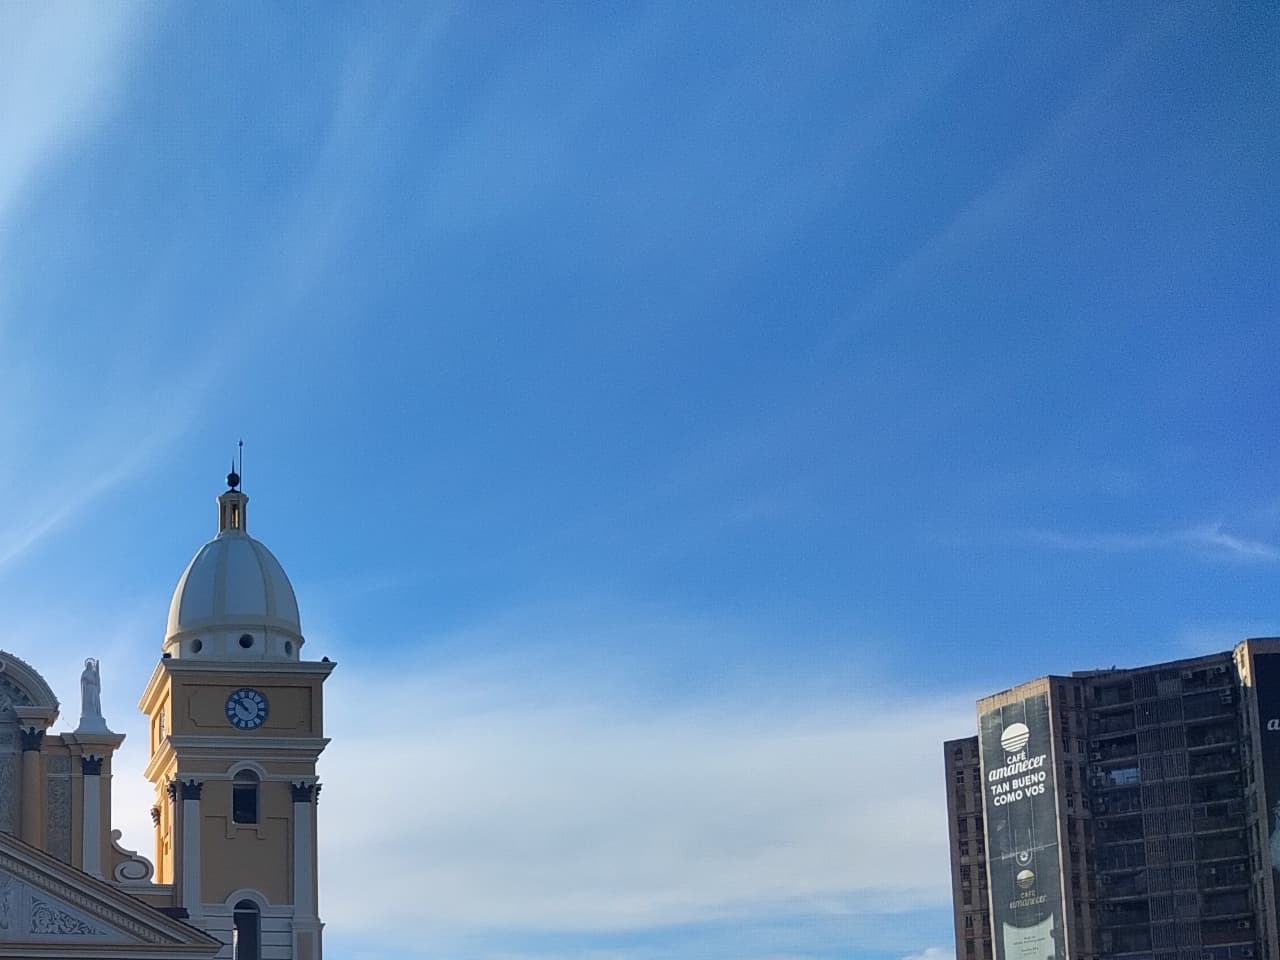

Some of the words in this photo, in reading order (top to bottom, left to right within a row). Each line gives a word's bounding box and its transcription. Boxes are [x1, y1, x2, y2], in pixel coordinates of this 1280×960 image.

[988, 754, 1047, 782] amanecer
[1006, 750, 1026, 764] CAFÉ
[990, 781, 1010, 796] TAN
[1012, 771, 1046, 789] BUENO
[993, 790, 1023, 807] COMO
[1024, 783, 1045, 798] VOS
